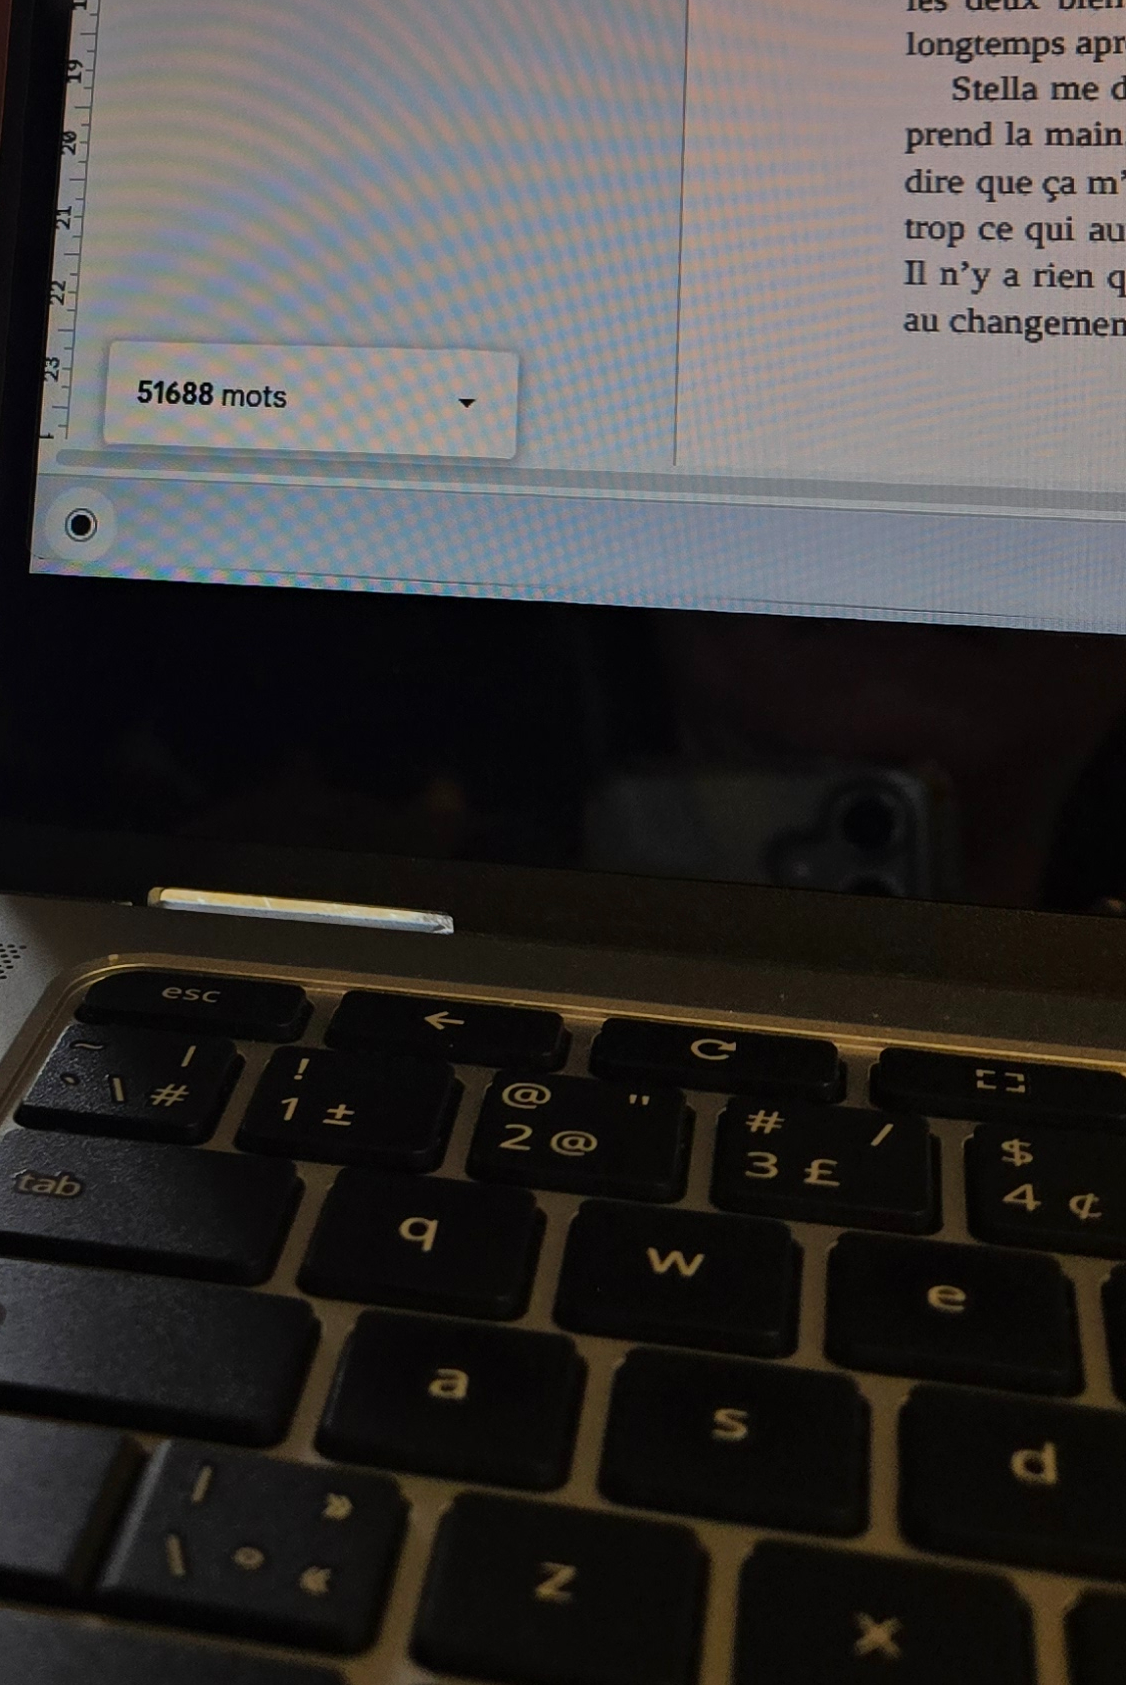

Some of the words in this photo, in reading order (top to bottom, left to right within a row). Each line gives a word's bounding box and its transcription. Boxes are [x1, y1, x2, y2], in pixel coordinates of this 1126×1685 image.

[906, 32, 1065, 63] longtemps
[1076, 35, 1126, 63] apr
[68, 59, 83, 83] 19
[952, 76, 1038, 101] Stella
[1051, 81, 1098, 100] me
[62, 130, 77, 155] 20
[905, 121, 993, 154] prend
[1005, 121, 1032, 146] la
[1045, 121, 1126, 147] main
[905, 169, 964, 194] dire
[976, 175, 1032, 202] que
[1043, 176, 1077, 202] ça
[56, 205, 72, 230] 21
[905, 219, 964, 247] trop
[979, 221, 1014, 240] ce
[1025, 216, 1076, 249] qui
[1089, 222, 1126, 242] au
[904, 260, 927, 285] Il
[1003, 268, 1020, 287] a
[1033, 262, 1094, 289] rien
[50, 280, 66, 306] 22
[904, 312, 940, 333] au
[45, 356, 61, 382] 23
[137, 379, 214, 406] 51688
[222, 384, 287, 409] mots
[162, 984, 221, 1003] esc
[294, 1058, 309, 1080] !
[281, 1097, 298, 1120] 1
[502, 1082, 551, 1109] @
[746, 1110, 784, 1135] #
[499, 1124, 532, 1151] 2
[550, 1130, 598, 1156] @
[1002, 1138, 1034, 1167] $
[746, 1151, 778, 1179] 3
[803, 1159, 840, 1187] £
[17, 1173, 82, 1198] tab
[1003, 1183, 1041, 1212] 4
[399, 1215, 437, 1252] q
[645, 1246, 705, 1278] w
[926, 1283, 968, 1314] e
[428, 1366, 468, 1400] a
[711, 1408, 750, 1441] s
[1011, 1443, 1058, 1486] d
[535, 1563, 576, 1601] z
[855, 1611, 902, 1658] x
